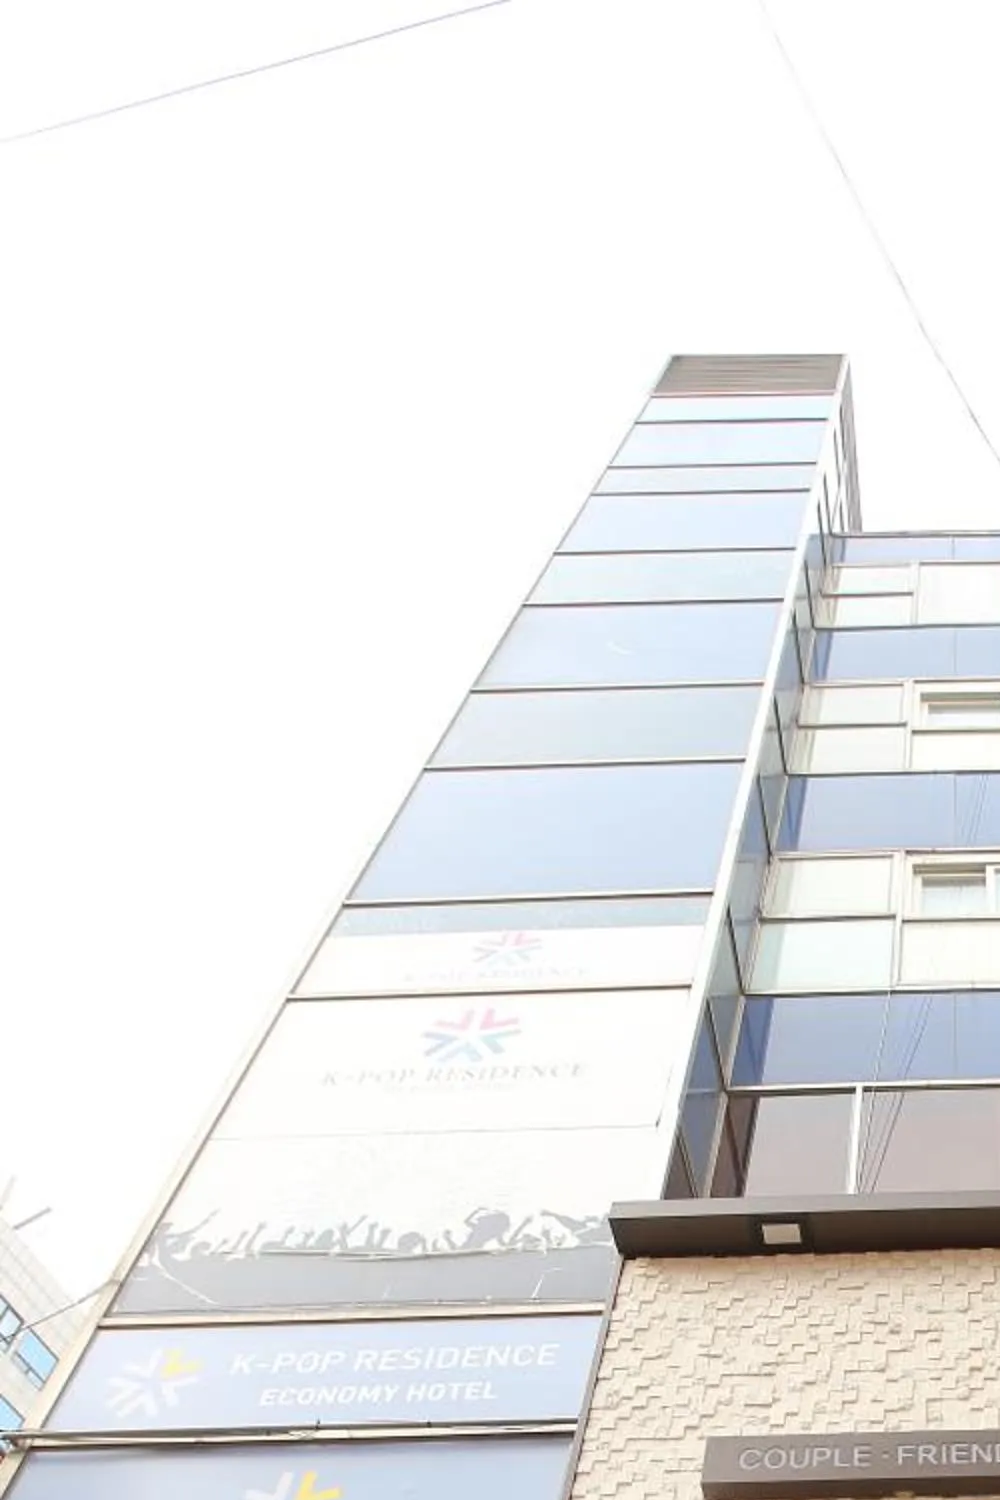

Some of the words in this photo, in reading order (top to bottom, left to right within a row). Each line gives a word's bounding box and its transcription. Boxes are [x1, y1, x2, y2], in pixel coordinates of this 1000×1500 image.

[321, 1066, 417, 1087] K-POP
[425, 1062, 589, 1082] RESIDENCE
[231, 1348, 345, 1376] K-POP
[352, 1342, 560, 1372] RESIDENCE
[259, 1383, 399, 1407] ECONOMY
[406, 1381, 498, 1403] HOTEL
[739, 1445, 871, 1471] COUPLE
